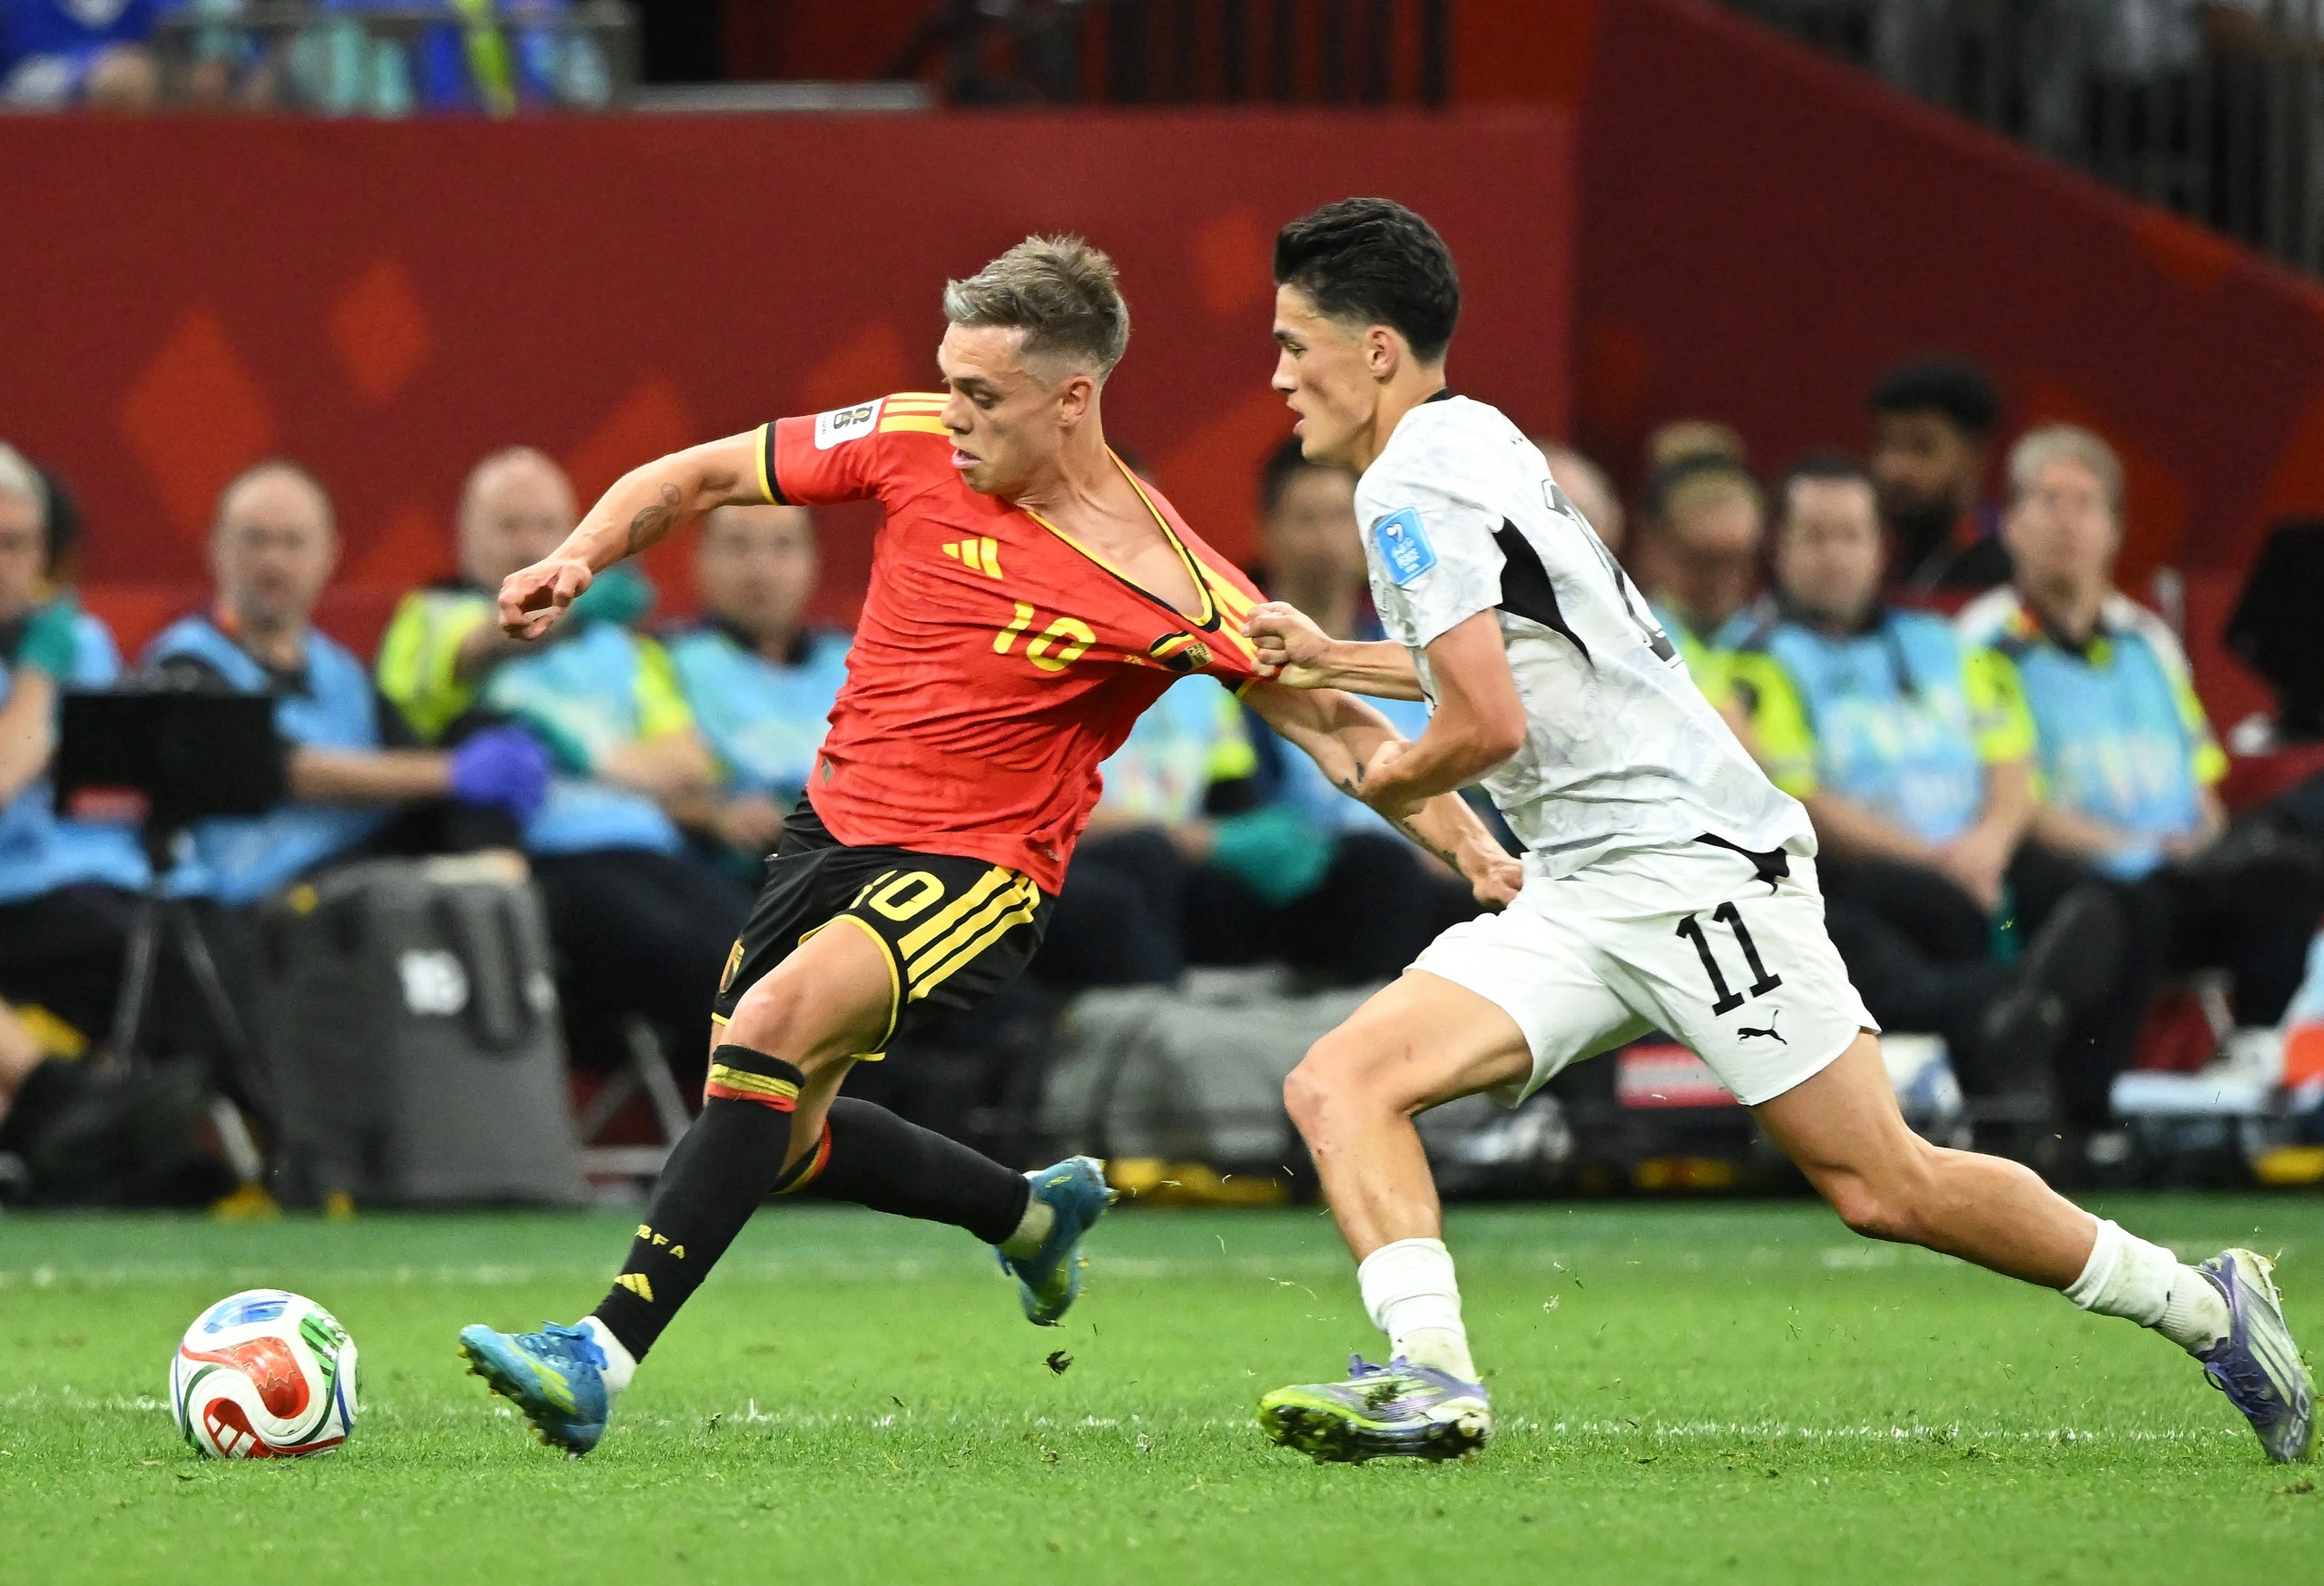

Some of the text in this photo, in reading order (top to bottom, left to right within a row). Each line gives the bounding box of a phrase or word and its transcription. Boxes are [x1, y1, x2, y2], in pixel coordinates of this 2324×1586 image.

[993, 601, 1097, 672] 10
[1676, 901, 1782, 1017] 11
[635, 1224, 685, 1259] BFA
